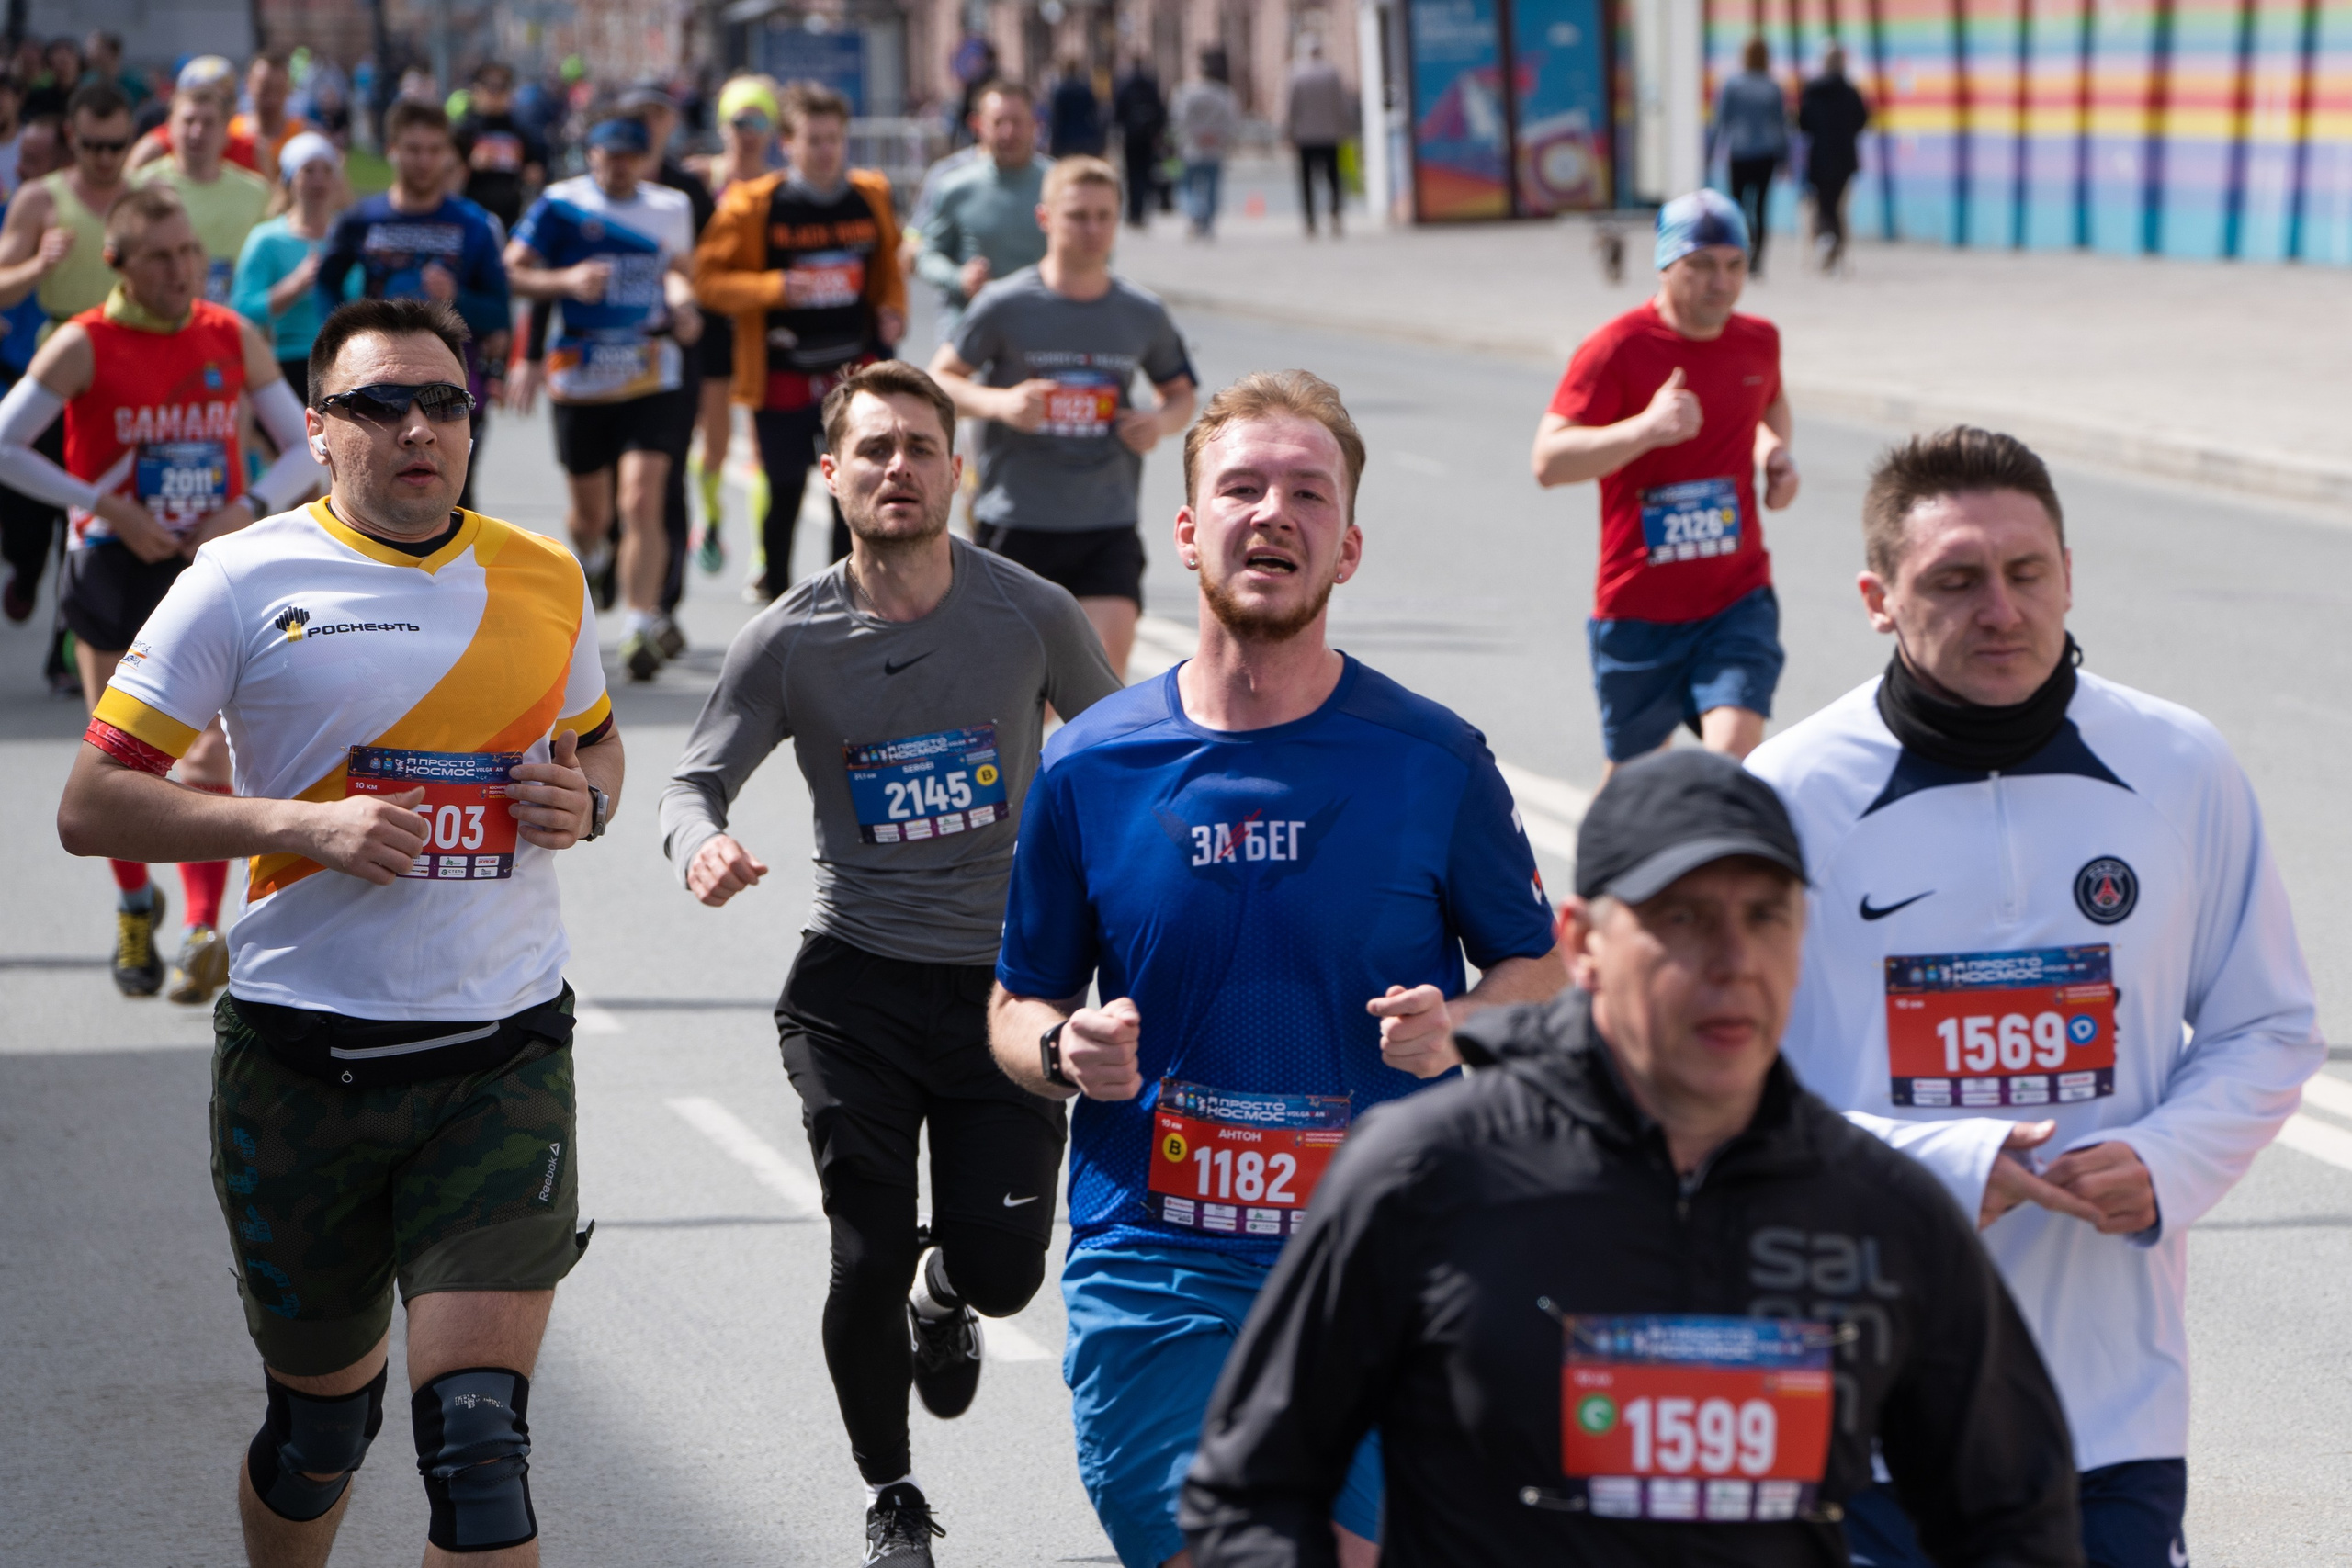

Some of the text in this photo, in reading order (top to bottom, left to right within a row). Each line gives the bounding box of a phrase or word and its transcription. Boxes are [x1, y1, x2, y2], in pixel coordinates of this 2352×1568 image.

[161, 467, 212, 498] 2011
[1663, 507, 1724, 544] 2126
[308, 623, 420, 638] РОСНЕФТЬ
[405, 765, 475, 777] КОСМОС
[419, 759, 475, 767] ПРОСТО
[884, 771, 972, 819] 2145
[1937, 1011, 2067, 1073] 1569
[1206, 1106, 1286, 1122] КОСМОС
[1208, 1097, 1286, 1111] Я ПРОСТО
[1218, 1129, 1261, 1142] АНТОН
[539, 1156, 558, 1201] Reebok
[1193, 1146, 1297, 1203] 1182
[1623, 1396, 1777, 1475] 1599
